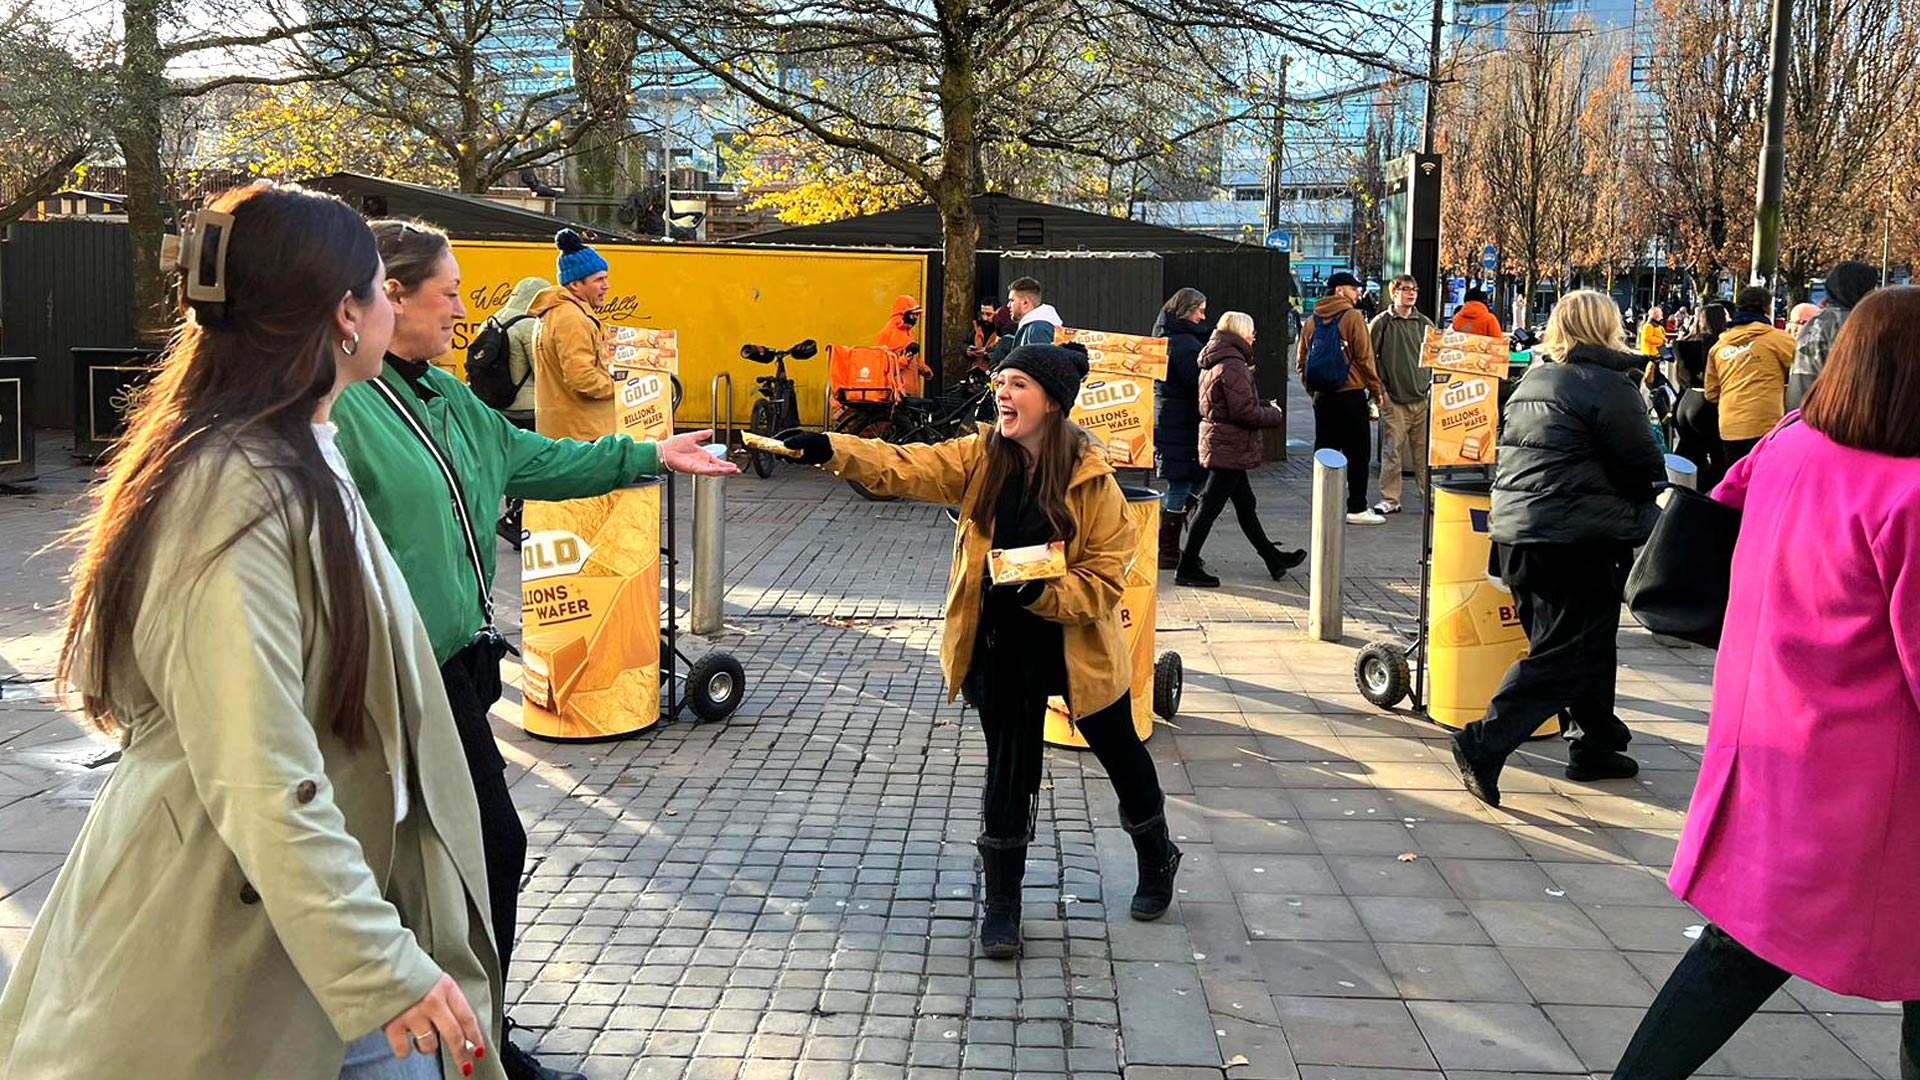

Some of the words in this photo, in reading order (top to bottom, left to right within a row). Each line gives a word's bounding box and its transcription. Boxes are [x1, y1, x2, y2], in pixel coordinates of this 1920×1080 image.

[625, 379, 659, 404] GOLD
[1080, 383, 1136, 407] GOLD
[1444, 382, 1486, 407] GOLD
[624, 404, 656, 425] BILLIONS
[643, 412, 664, 426] WAFER
[1078, 409, 1129, 426] BILLIONS
[1108, 417, 1140, 430] WAFER
[1441, 408, 1481, 427] BILLIONS
[1464, 414, 1488, 428] WAFER
[523, 537, 580, 571] OLD
[536, 599, 590, 620] WAFER
